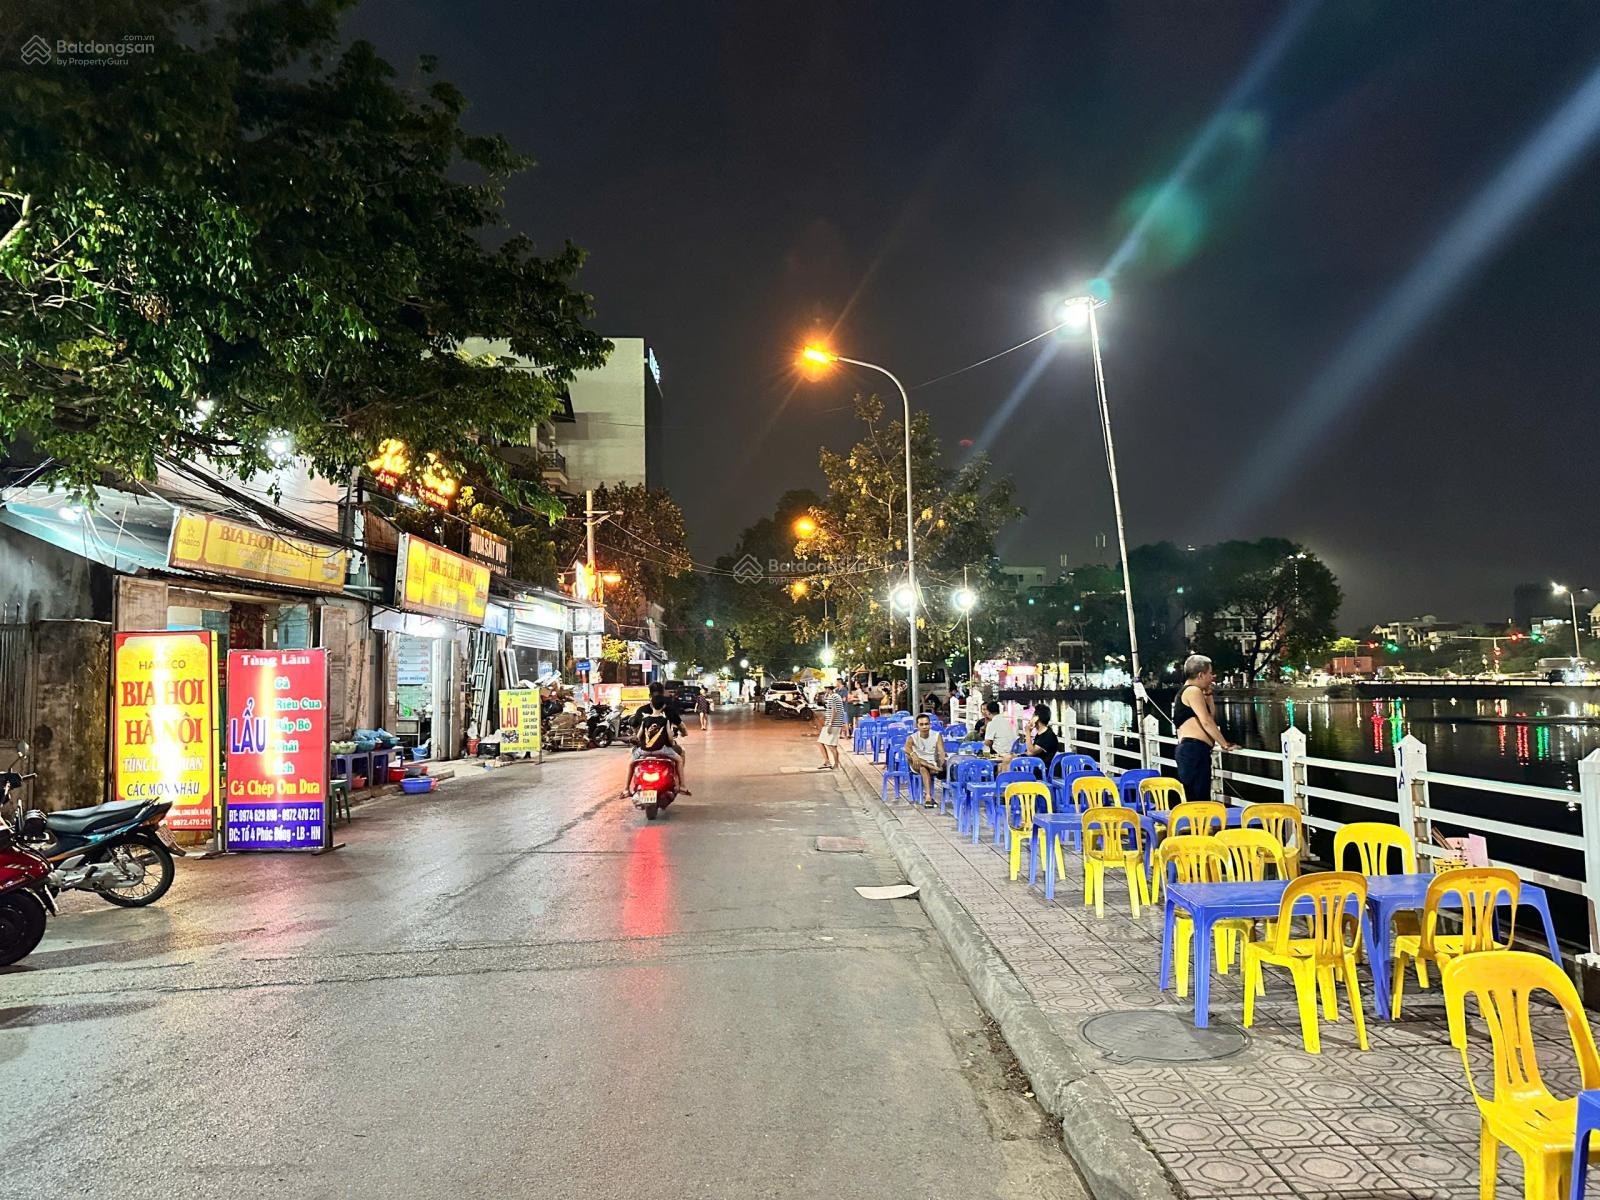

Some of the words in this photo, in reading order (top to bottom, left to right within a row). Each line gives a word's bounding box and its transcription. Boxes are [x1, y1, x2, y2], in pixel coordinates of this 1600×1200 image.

[219, 525, 246, 545] BIA
[138, 660, 187, 670] HACO
[121, 680, 156, 707] BIA
[164, 678, 205, 706] HƠI
[301, 699, 321, 709] Cua
[125, 712, 156, 745] HÀ
[231, 698, 267, 753] LẨU
[297, 719, 311, 730] Bò
[275, 740, 298, 752] hái
[126, 780, 146, 796] CÁC
[231, 780, 245, 796] Cá
[247, 780, 275, 798] Chép
[276, 779, 297, 795] Om
[309, 808, 320, 821] 211
[250, 828, 256, 841] 4
[296, 826, 306, 840] LB
[310, 825, 321, 840] HN
